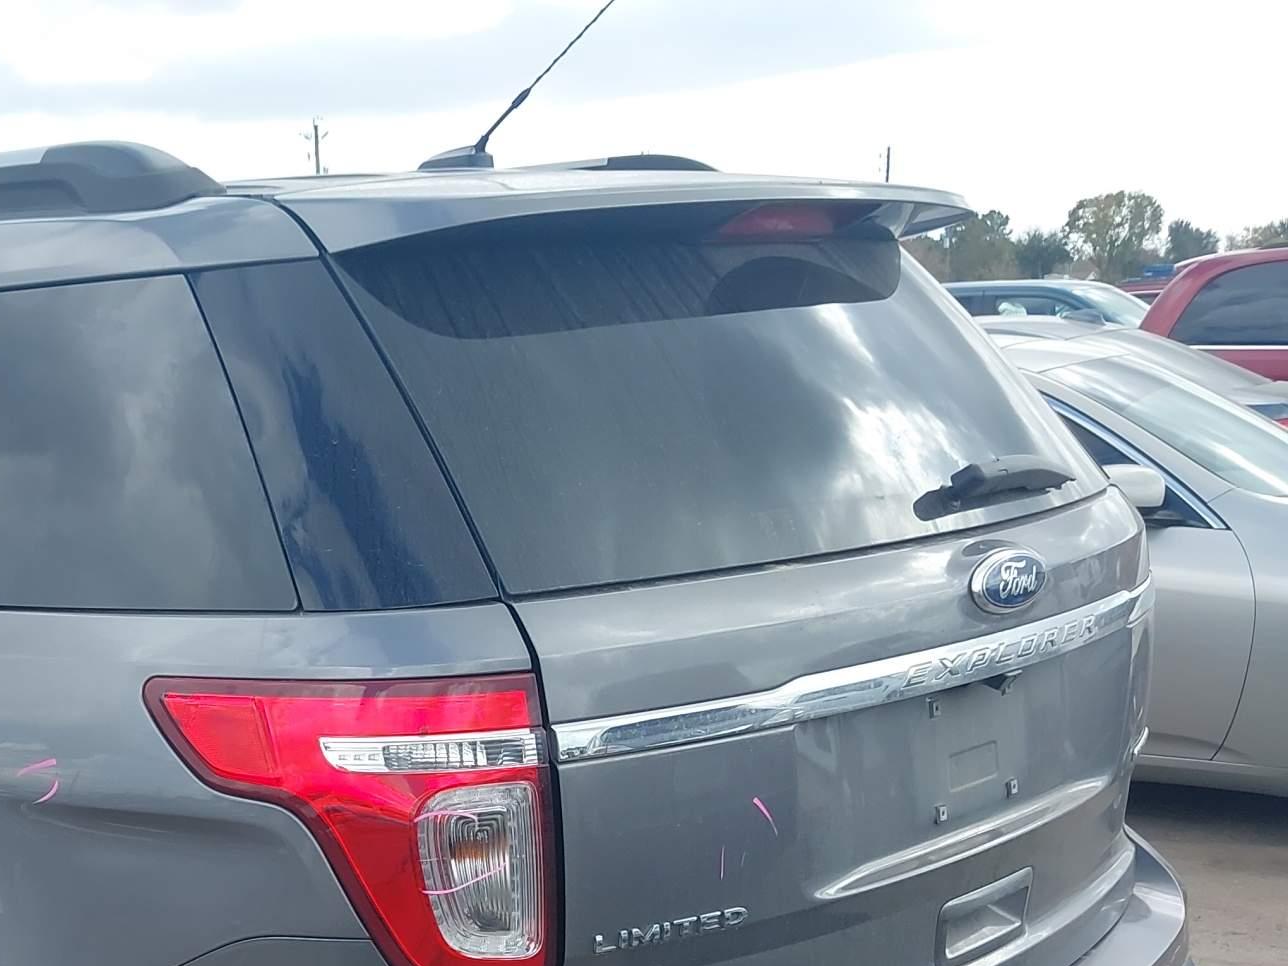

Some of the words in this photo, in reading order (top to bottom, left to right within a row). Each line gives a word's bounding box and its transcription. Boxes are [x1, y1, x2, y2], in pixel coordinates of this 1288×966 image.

[999, 560, 1038, 599] Ford
[900, 613, 1099, 690] EXPLORER
[593, 905, 750, 954] LIMITED
